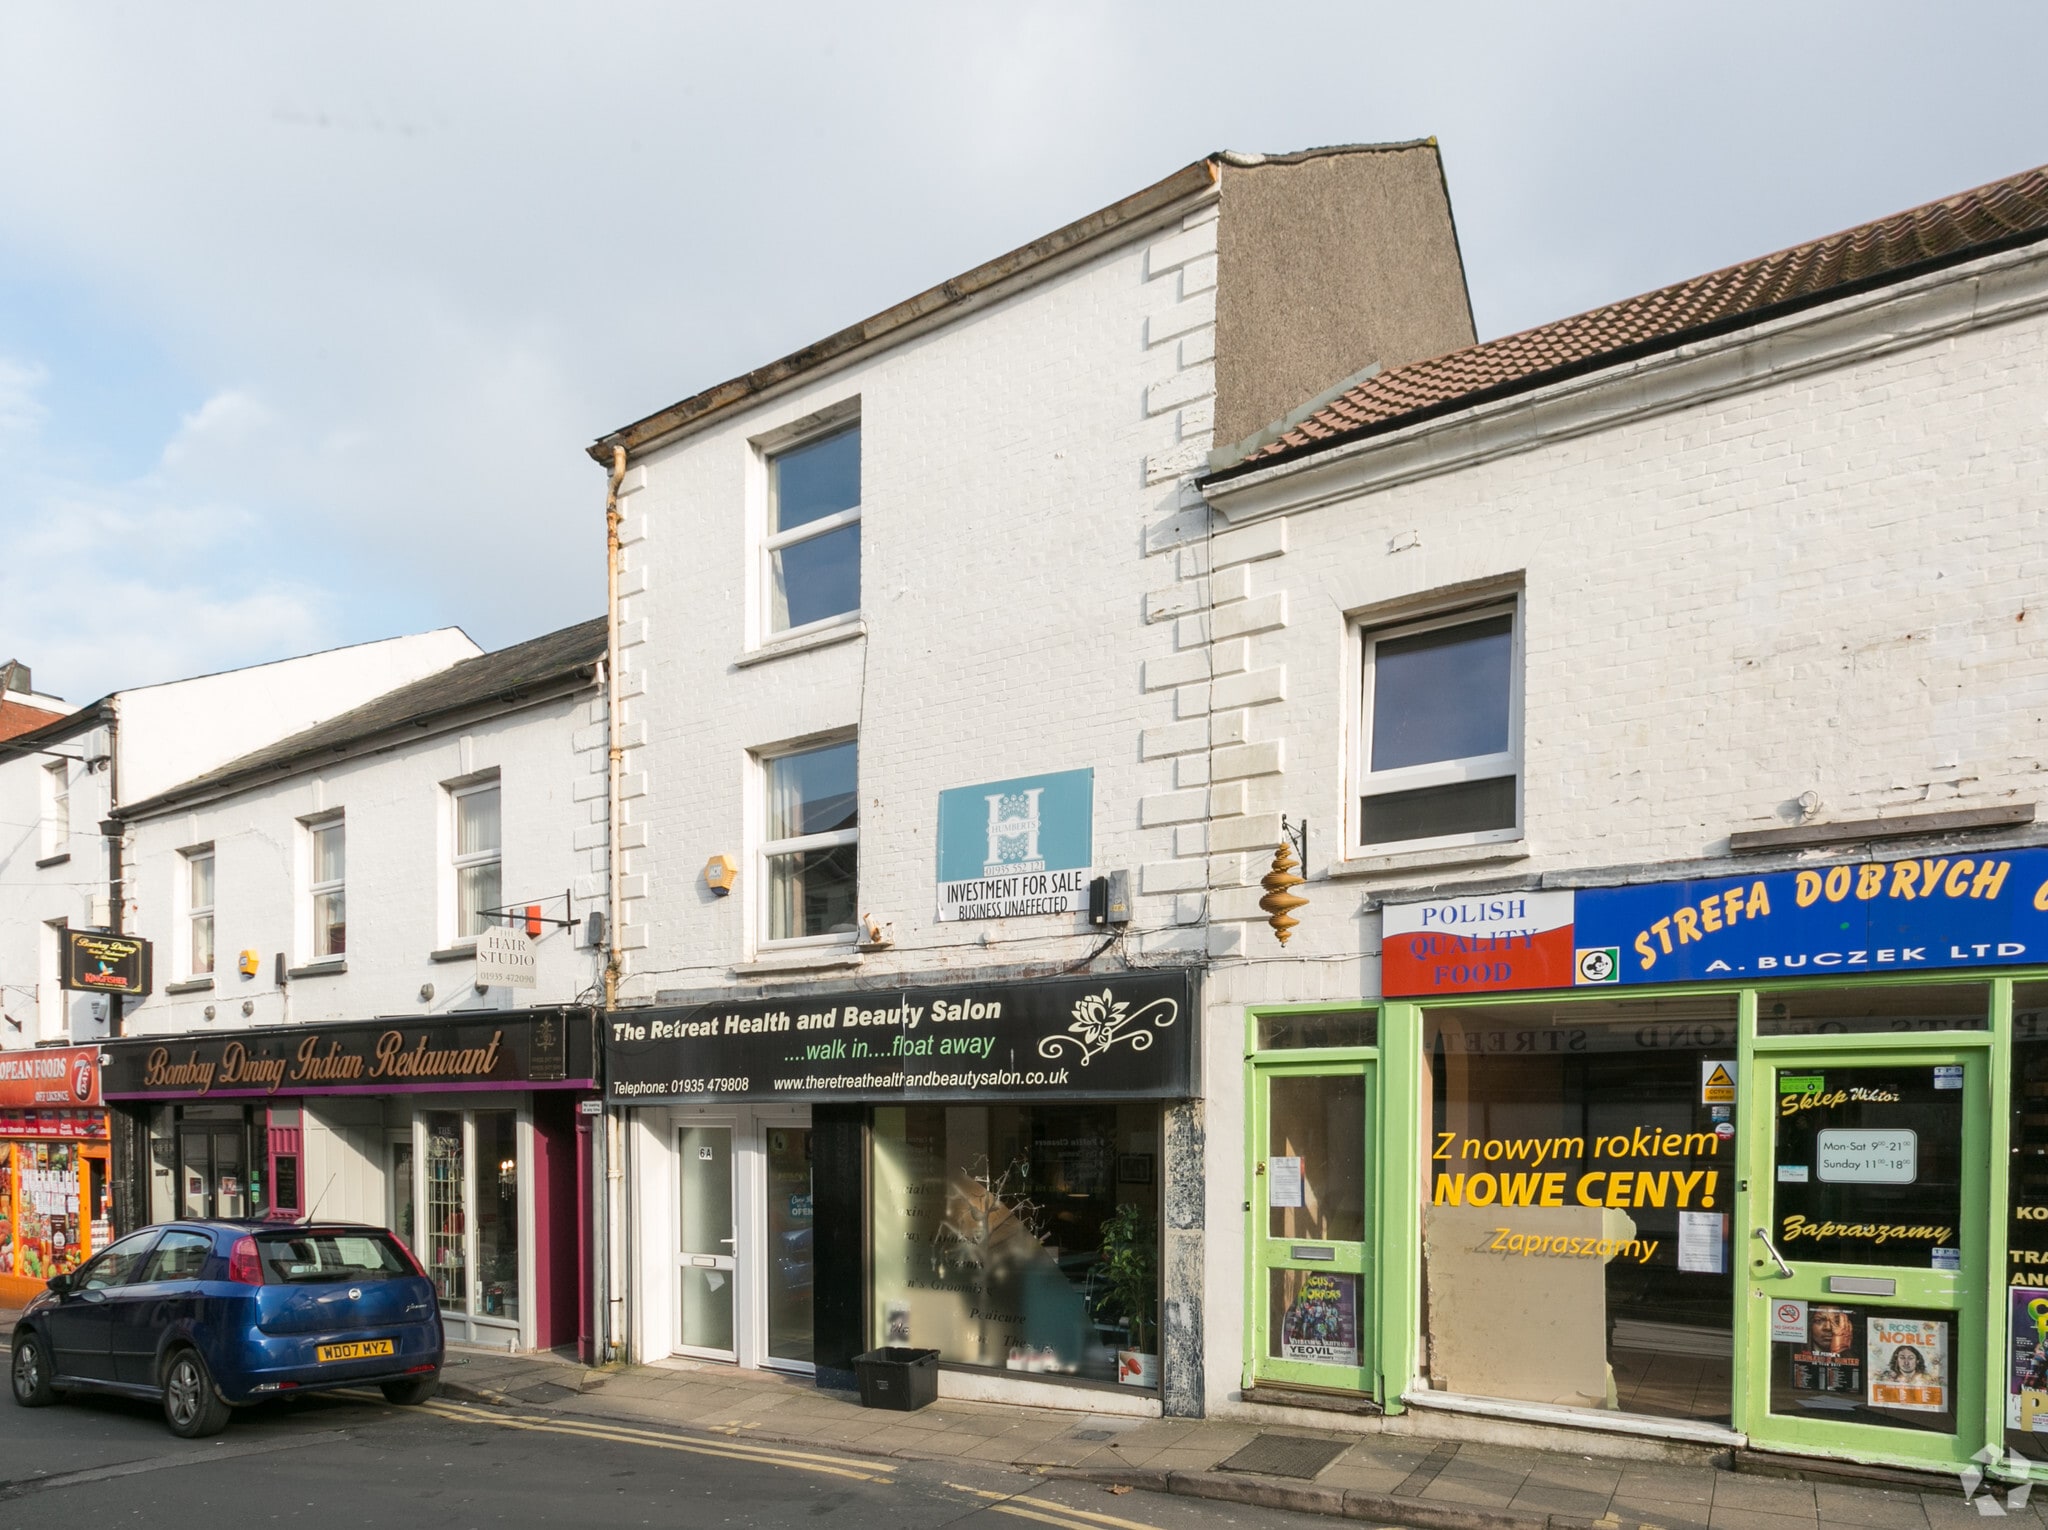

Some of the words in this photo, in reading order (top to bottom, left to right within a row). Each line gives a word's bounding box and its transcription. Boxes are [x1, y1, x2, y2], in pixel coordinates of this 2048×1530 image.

[991, 821, 1036, 834] HUMBERTS
[985, 865, 1009, 876] 01935
[1012, 863, 1027, 873] 552
[1030, 861, 1044, 871] 121
[947, 878, 1018, 903] INVESTMENT
[1023, 875, 1047, 896] FOR
[1051, 871, 1082, 893] SALE
[959, 901, 1000, 920] BUSINESS
[1004, 896, 1067, 917] UNAFFECTED
[1421, 899, 1526, 927] POLISH
[1634, 881, 1770, 970] STREFA
[1795, 858, 2011, 908] DOBRYCH
[489, 937, 526, 951] HAIR
[1409, 928, 1538, 961] QUALITY
[480, 951, 535, 966] STUDIO
[1705, 959, 1745, 972] A.
[1758, 947, 1926, 969] BUCZEK
[1951, 943, 2026, 959] LTD
[1433, 962, 1512, 985] FOOD
[613, 1023, 646, 1041] The
[650, 1017, 719, 1040] Retreat
[724, 1011, 790, 1034] Health
[796, 1008, 837, 1030] and
[843, 1003, 924, 1028] Beauty
[931, 999, 1002, 1022] Salon
[939, 1036, 996, 1059] away
[35, 1057, 66, 1078] FOODS
[144, 1046, 216, 1095] Bombay
[219, 1041, 287, 1094] Dining
[290, 1035, 364, 1081] Indian
[368, 1030, 503, 1079] Restaurant
[614, 1081, 669, 1097] Telephone:
[671, 1079, 704, 1093] 01935
[707, 1077, 749, 1092] 479808
[774, 1068, 1069, 1090] www.theretreathealthandbeautysalon.co.uk
[1781, 1090, 1848, 1116] Sklep
[1432, 1132, 1456, 1159] Z
[1461, 1136, 1585, 1168] nowym
[1594, 1127, 1718, 1158] rokiem
[1823, 1142, 1866, 1151] Mon-Sat
[1823, 1159, 1861, 1171] Sunday
[1434, 1172, 1567, 1208] NOWE
[1575, 1171, 1719, 1208] CENY!
[2016, 1207, 2048, 1220] KO
[1782, 1214, 1953, 1244] Zapraszamy
[1490, 1228, 1659, 1263] Zapraszamy
[2011, 1272, 2048, 1286] AN
[1879, 1331, 1936, 1346] NOBLE
[1888, 1323, 1918, 1332] ROSS
[323, 1342, 358, 1359] WD07
[363, 1342, 388, 1355] MYZ
[1289, 1346, 1334, 1355] YEOVIL
